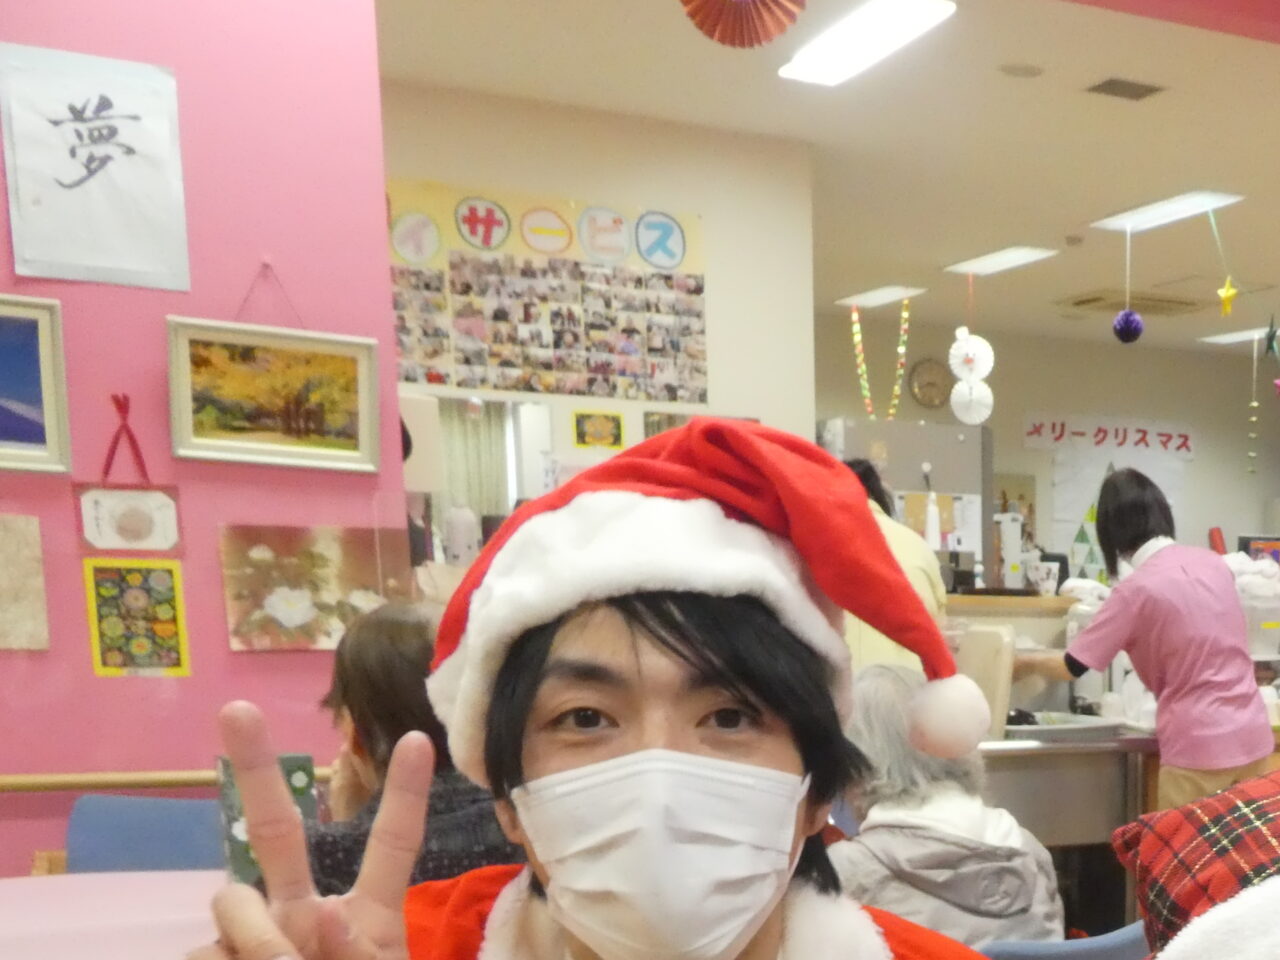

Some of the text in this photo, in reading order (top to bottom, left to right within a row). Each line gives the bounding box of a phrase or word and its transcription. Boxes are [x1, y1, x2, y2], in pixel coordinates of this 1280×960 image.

[47, 94, 141, 189] 夢
[1026, 421, 1192, 452] メリークリスマス
